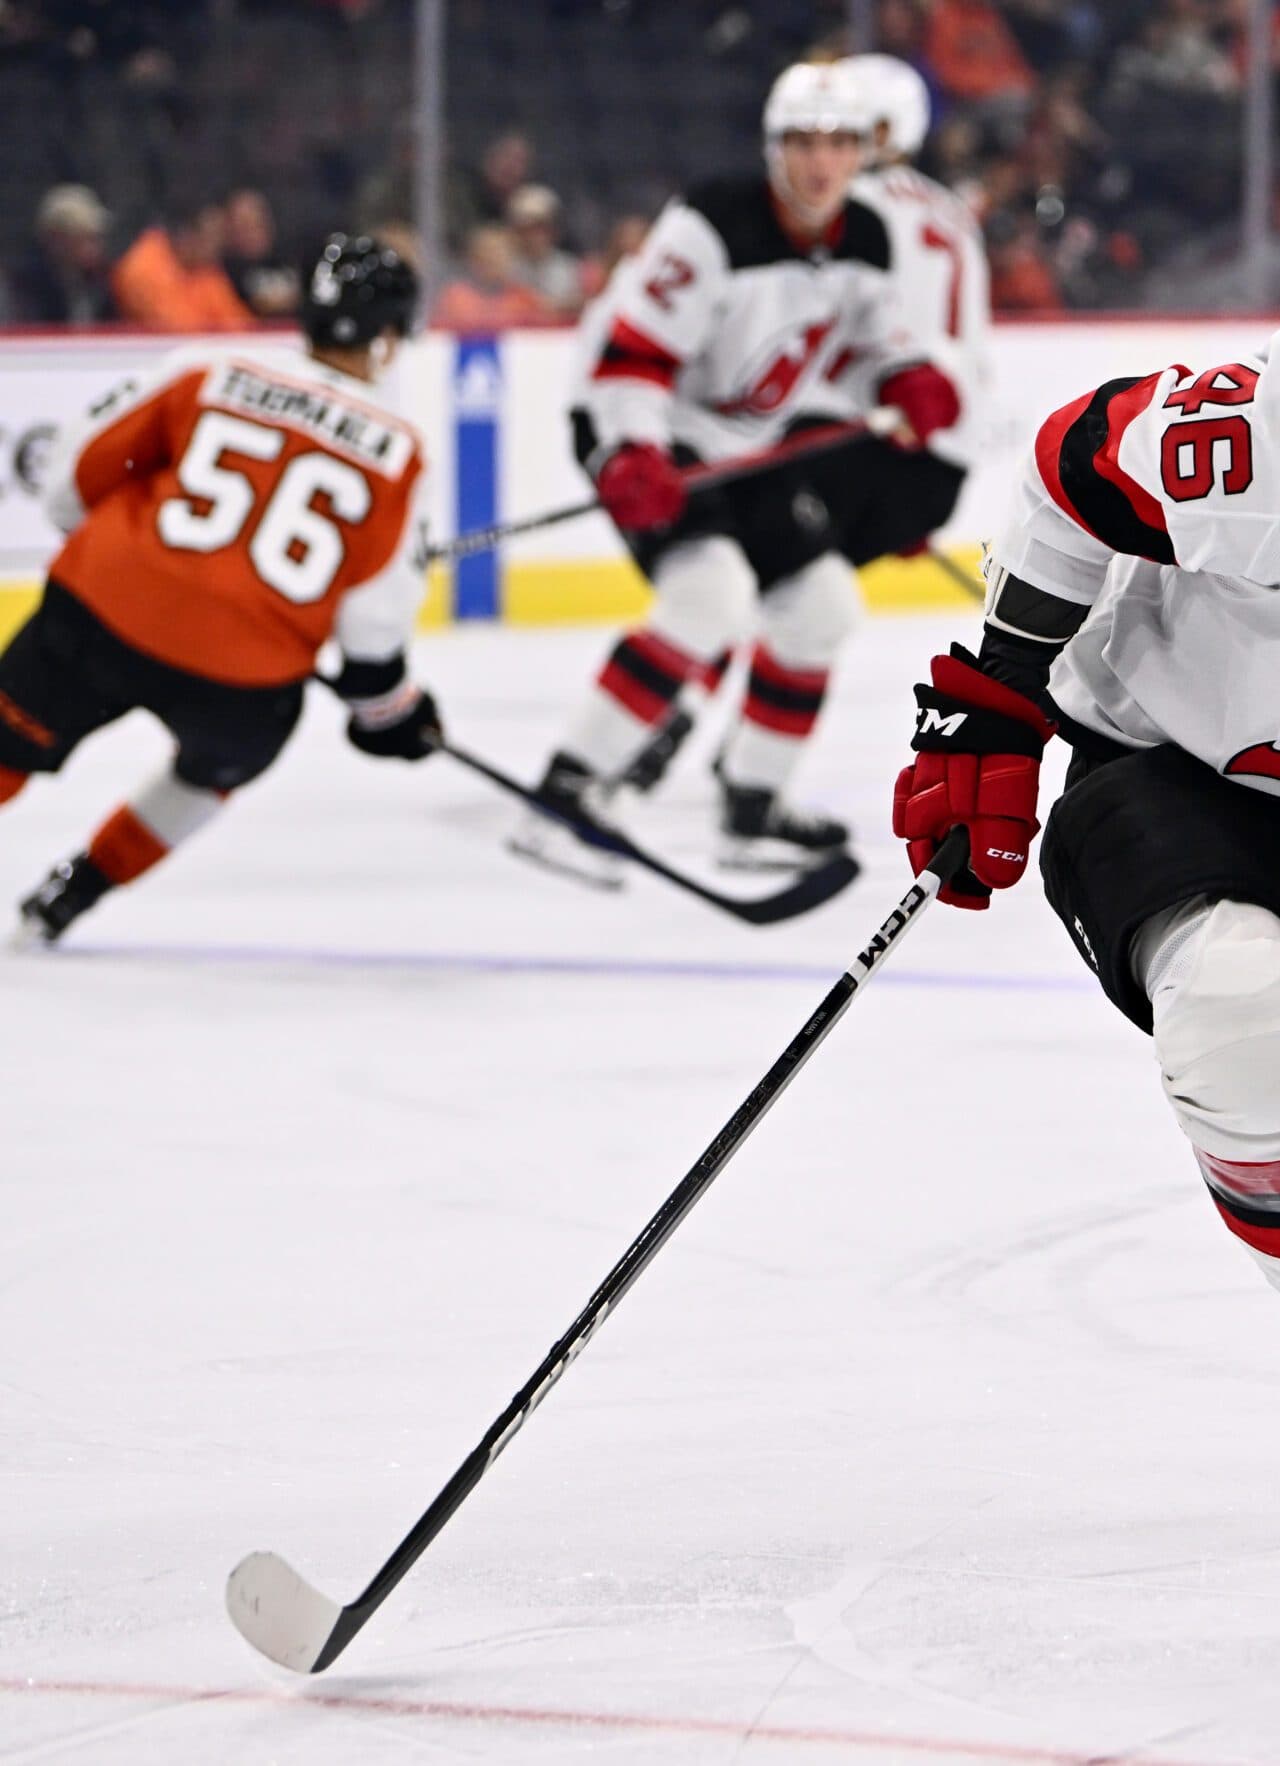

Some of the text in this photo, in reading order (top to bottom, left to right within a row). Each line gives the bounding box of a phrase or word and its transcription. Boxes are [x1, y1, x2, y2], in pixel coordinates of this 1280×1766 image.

[1161, 362, 1262, 504] 46
[157, 409, 372, 605] 56
[986, 846, 1025, 863] CCM
[857, 884, 928, 970] CCM
